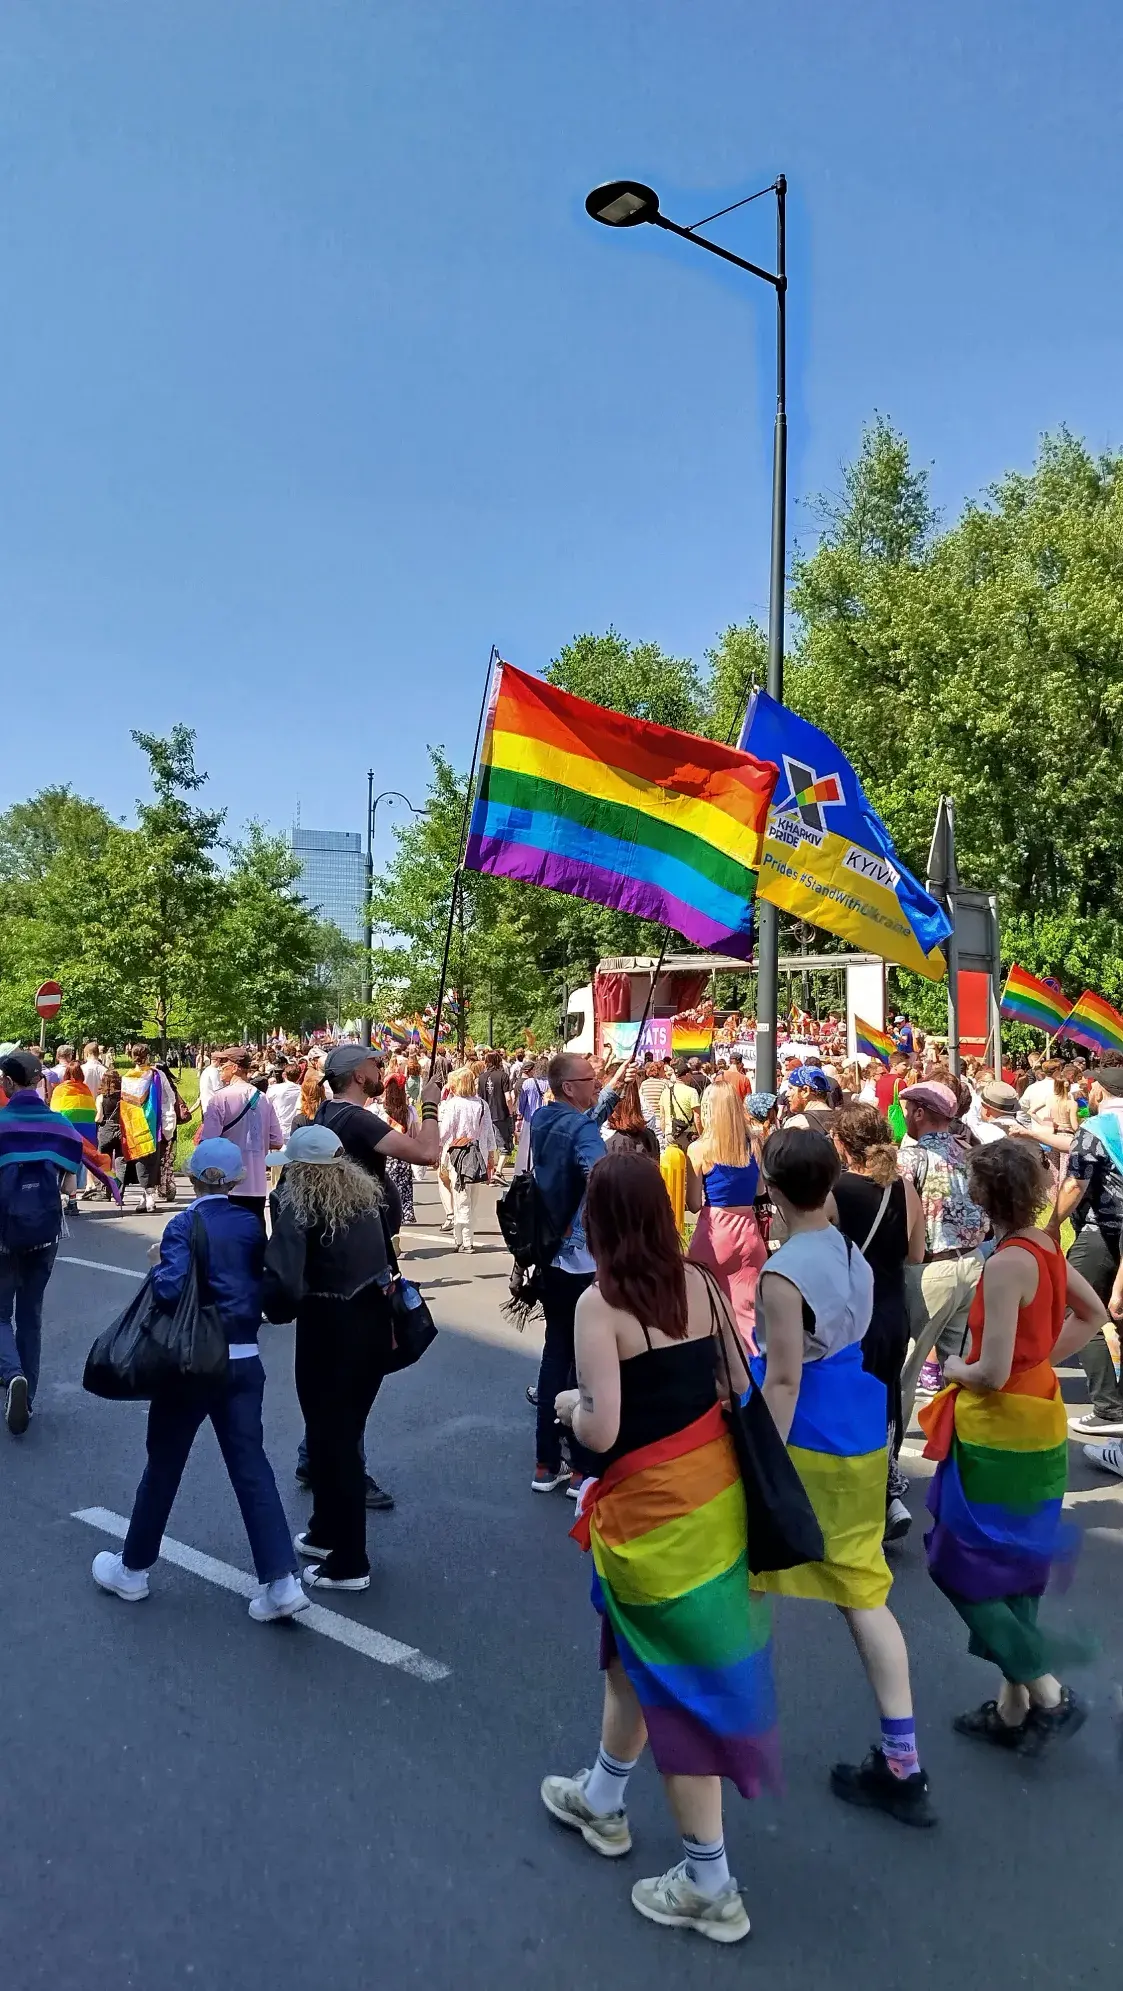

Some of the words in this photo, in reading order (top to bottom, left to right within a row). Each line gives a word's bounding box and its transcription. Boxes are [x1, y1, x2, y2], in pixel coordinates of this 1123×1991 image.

[769, 826, 799, 847] PRIDE
[778, 818, 822, 846] KHARKIV
[763, 853, 799, 880] Prides
